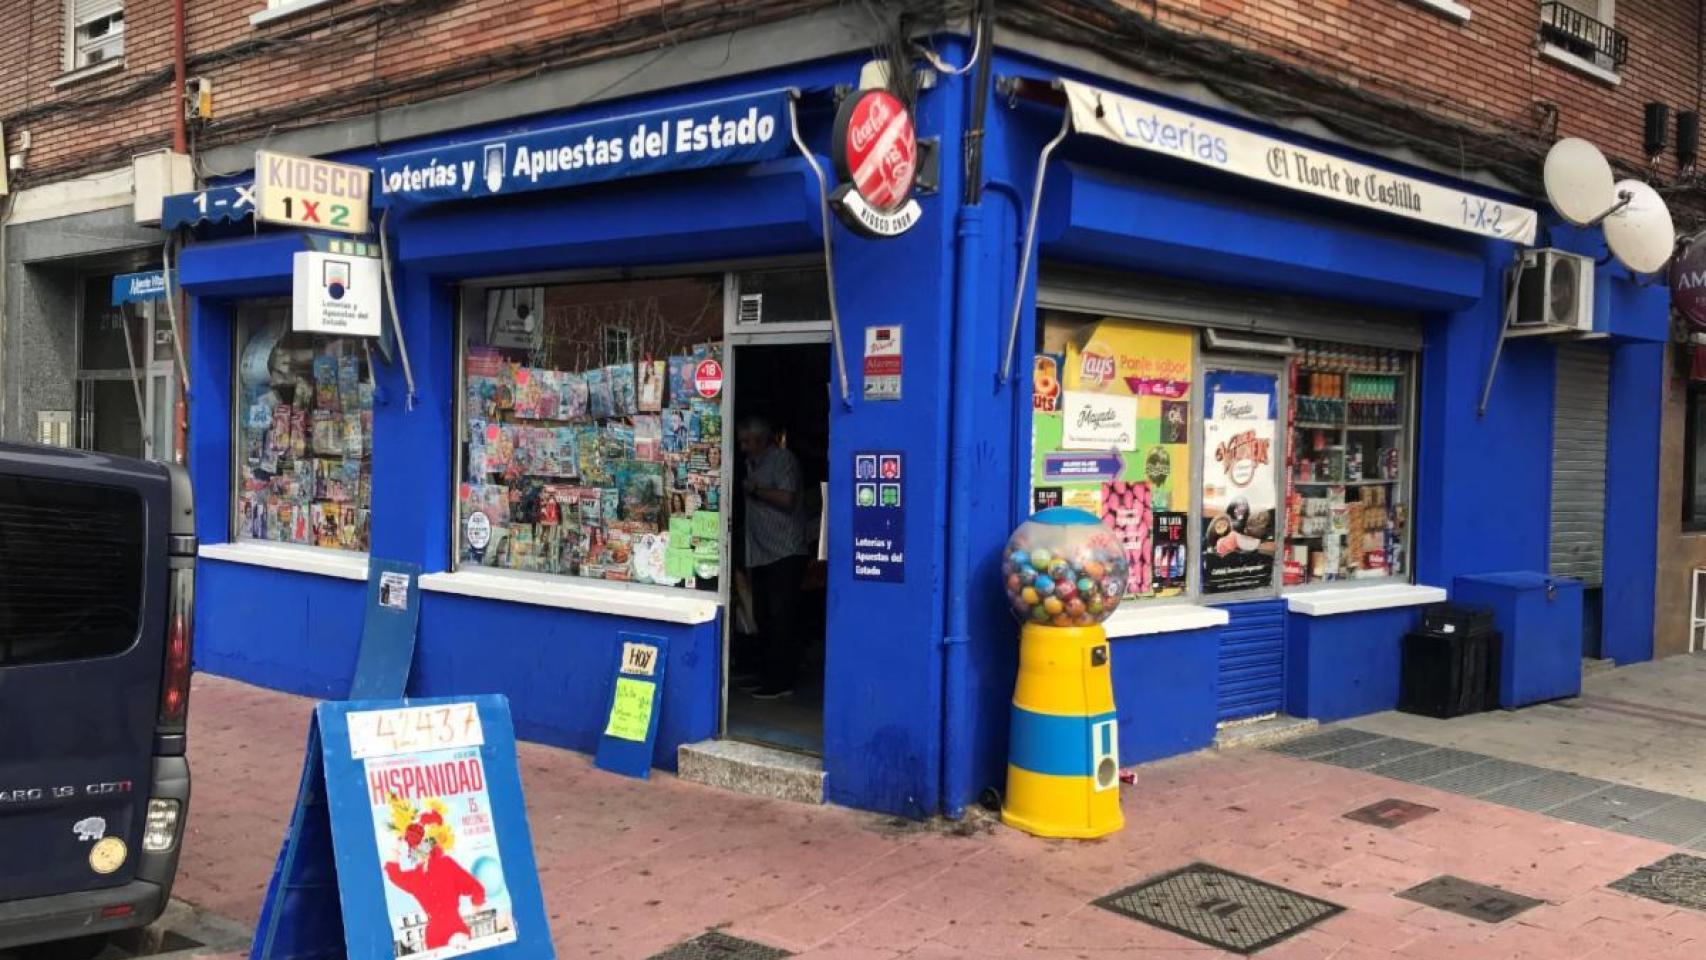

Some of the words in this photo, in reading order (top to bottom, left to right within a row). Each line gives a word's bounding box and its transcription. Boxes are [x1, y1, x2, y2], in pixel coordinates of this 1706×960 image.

[512, 137, 624, 182] Apuestas
[629, 121, 669, 160] del
[675, 107, 776, 152] Estado
[1117, 103, 1228, 164] Loterías
[268, 157, 364, 201] KIOSCO
[381, 158, 457, 194] Loterías
[461, 159, 475, 191] y
[1460, 198, 1502, 233] 1-X-2
[856, 552, 889, 562] Apuestas
[891, 553, 903, 562] del
[856, 566, 881, 575] Estado
[376, 705, 476, 748] 42437
[370, 759, 483, 806] HISPANIDAD
